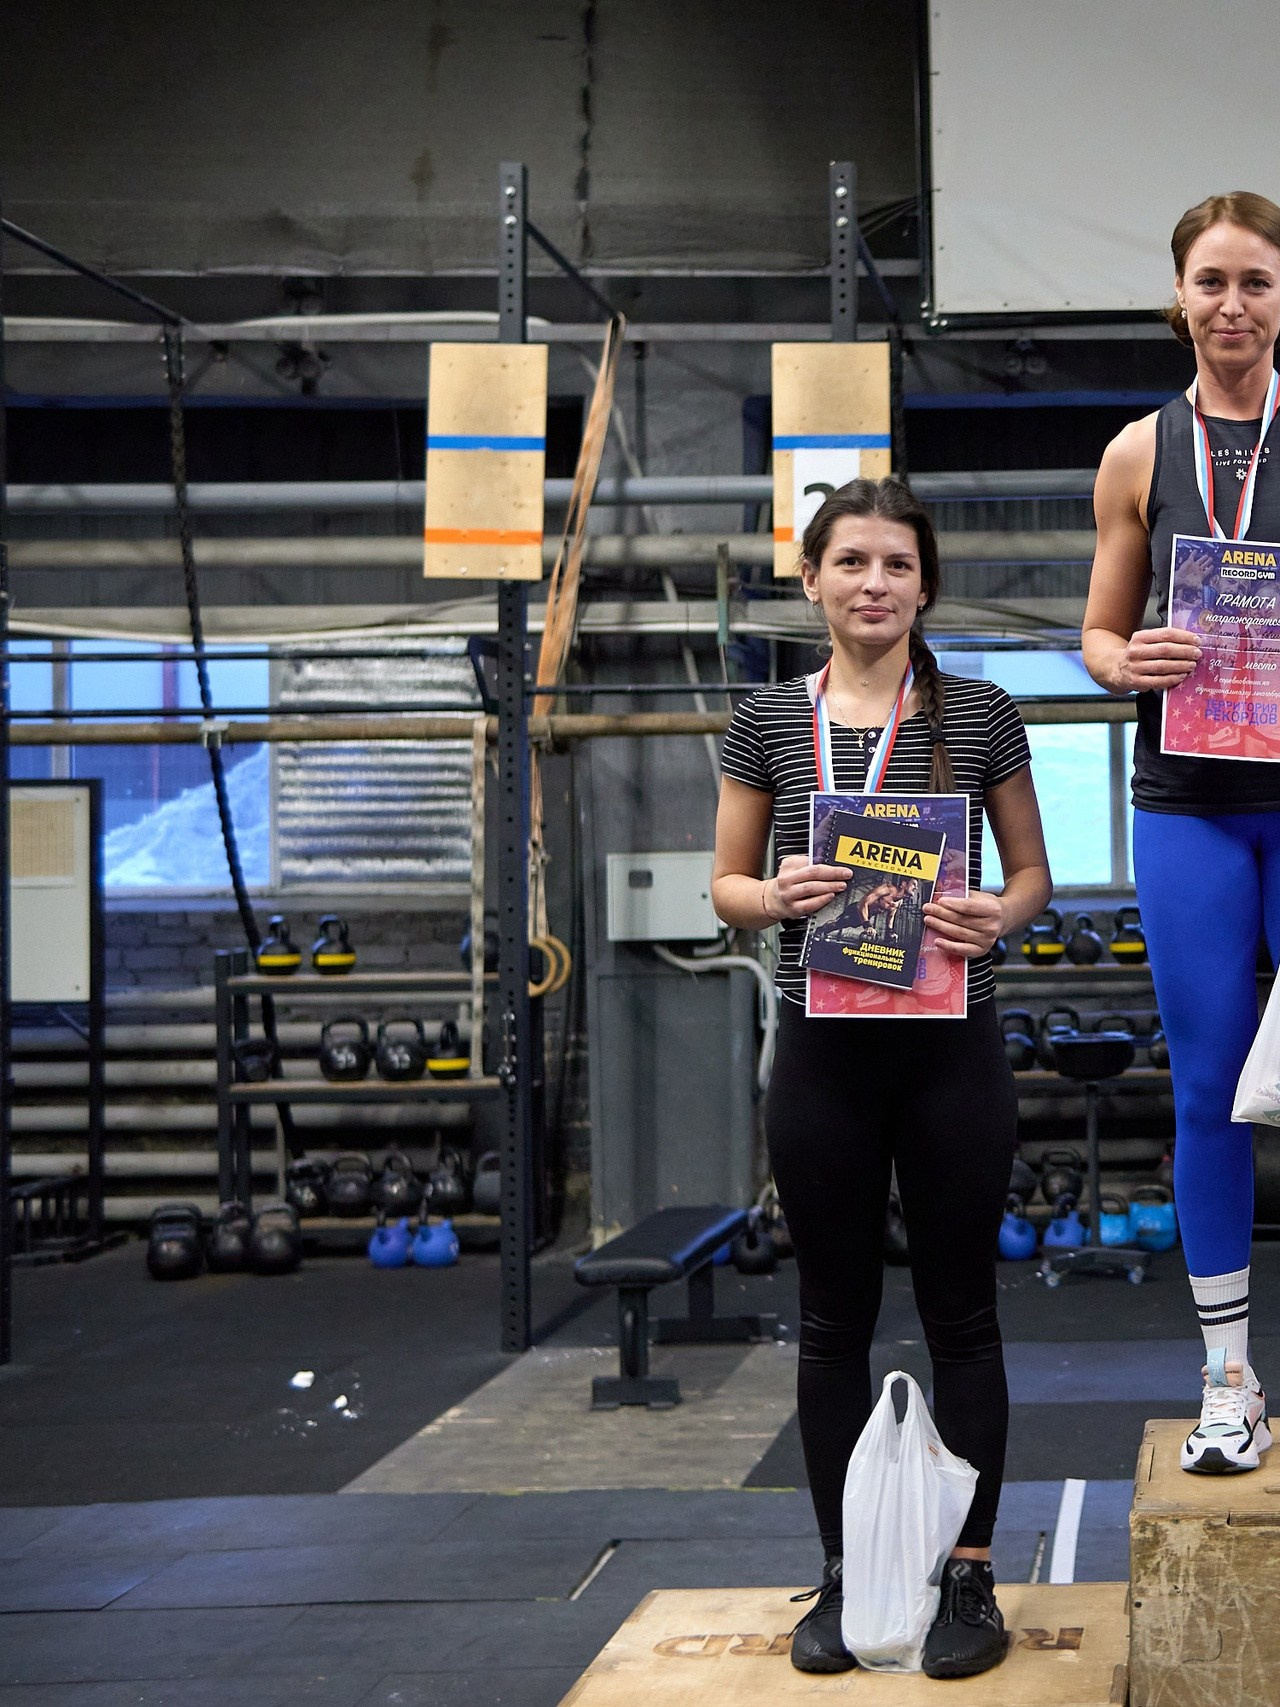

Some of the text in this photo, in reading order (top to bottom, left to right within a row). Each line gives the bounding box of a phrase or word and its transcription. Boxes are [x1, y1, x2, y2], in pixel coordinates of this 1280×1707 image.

[1211, 447, 1270, 457] LES MILS
[1221, 550, 1277, 567] ARENA
[1222, 569, 1256, 578] RECORD
[1216, 594, 1277, 609] ГРАМОТА
[1209, 659, 1221, 670] за
[1243, 662, 1277, 670] место
[1205, 699, 1278, 713] ТЕРРИТОРИЯ
[1204, 709, 1277, 726] РЕКОРДОВ
[862, 803, 920, 818] ARENA
[849, 841, 922, 870] ARENA
[856, 860, 913, 874] FUNCTIONAL
[842, 947, 904, 964] функциональных
[860, 942, 906, 958] ДНЕВНИК
[854, 956, 903, 972] тренировок
